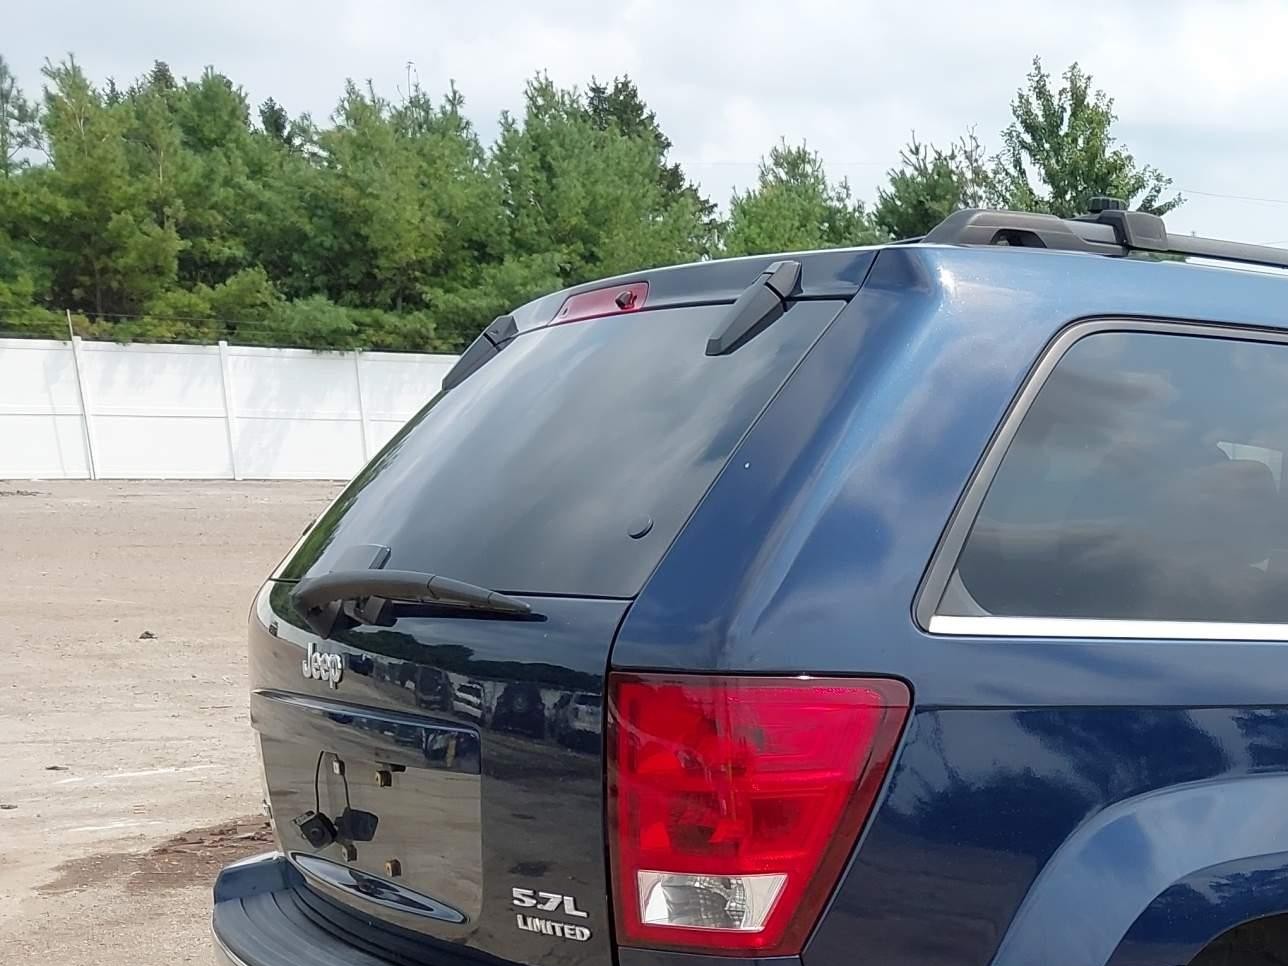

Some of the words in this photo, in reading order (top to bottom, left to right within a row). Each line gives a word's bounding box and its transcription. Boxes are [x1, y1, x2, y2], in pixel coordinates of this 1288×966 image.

[302, 642, 343, 689] Jeep
[512, 887, 589, 918] 5.7L
[516, 913, 592, 941] LIMITED
